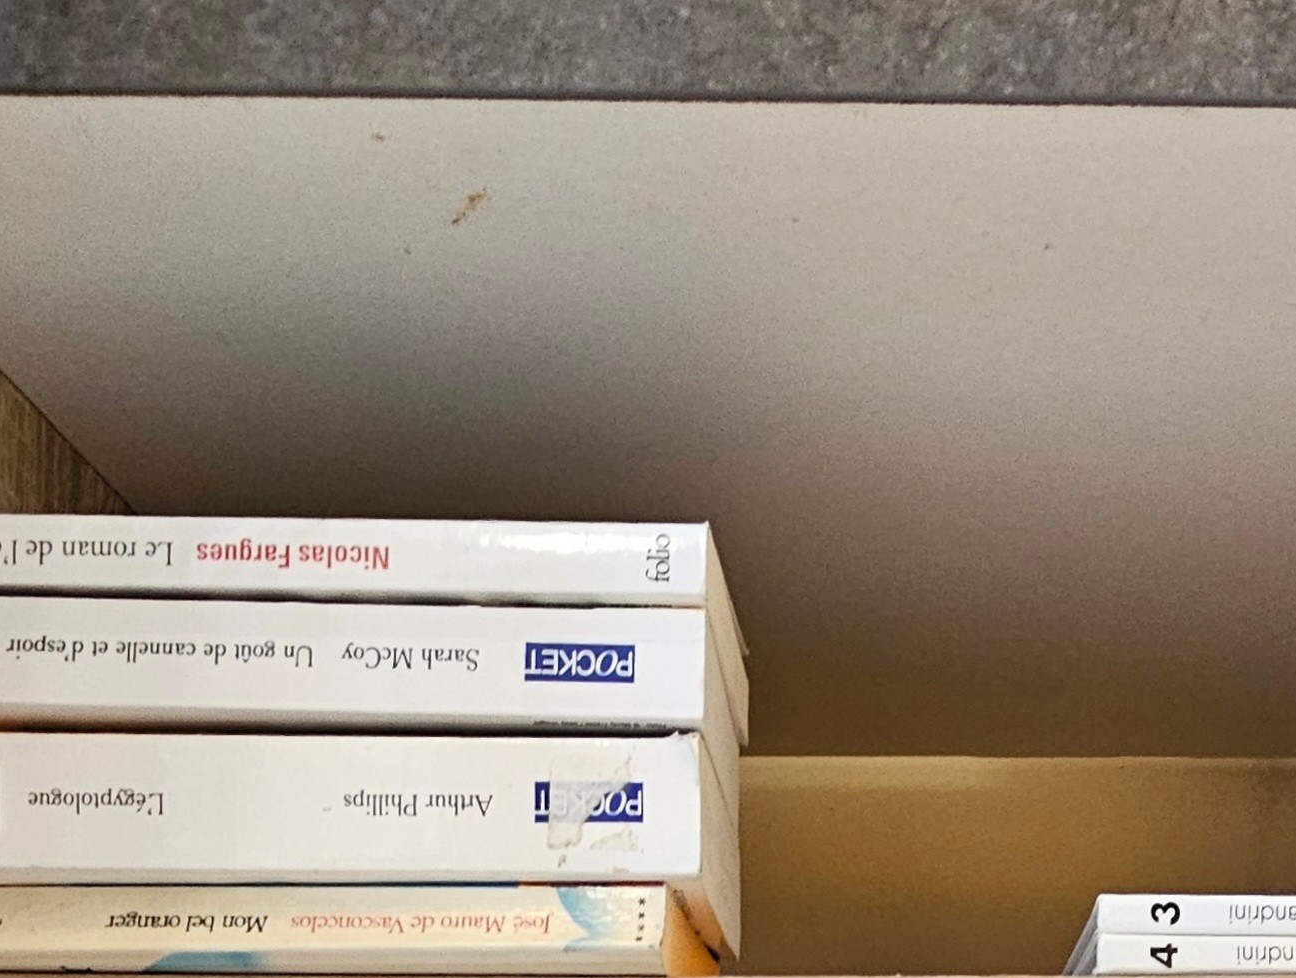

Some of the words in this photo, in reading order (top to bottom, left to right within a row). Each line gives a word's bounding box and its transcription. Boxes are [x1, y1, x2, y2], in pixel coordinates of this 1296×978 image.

[25, 540, 54, 566] de
[63, 540, 136, 558] roman
[146, 541, 173, 566] Le
[196, 538, 291, 568] Fargues
[299, 545, 389, 570] Nicolas
[646, 533, 670, 582] folio
[5, 635, 84, 662] d'espoir
[91, 640, 109, 658] et
[115, 640, 197, 664] cannelle
[203, 642, 227, 665] de
[234, 640, 276, 664] goût
[284, 645, 313, 667] Un
[342, 642, 413, 670] McCoy
[420, 647, 480, 671] Sarah
[526, 644, 635, 681] POCKET
[28, 788, 164, 816] L'égyptologue
[343, 789, 418, 817] Phillips
[424, 793, 493, 817] Arthur
[106, 912, 181, 930] oranger
[186, 914, 214, 933] bel
[221, 916, 269, 934] Mon
[291, 915, 405, 934] Vasconcelos
[410, 916, 435, 933] de
[440, 915, 506, 933] Mauro
[513, 915, 552, 935] José
[1150, 902, 1180, 925] 3
[1150, 943, 1178, 969] 4
